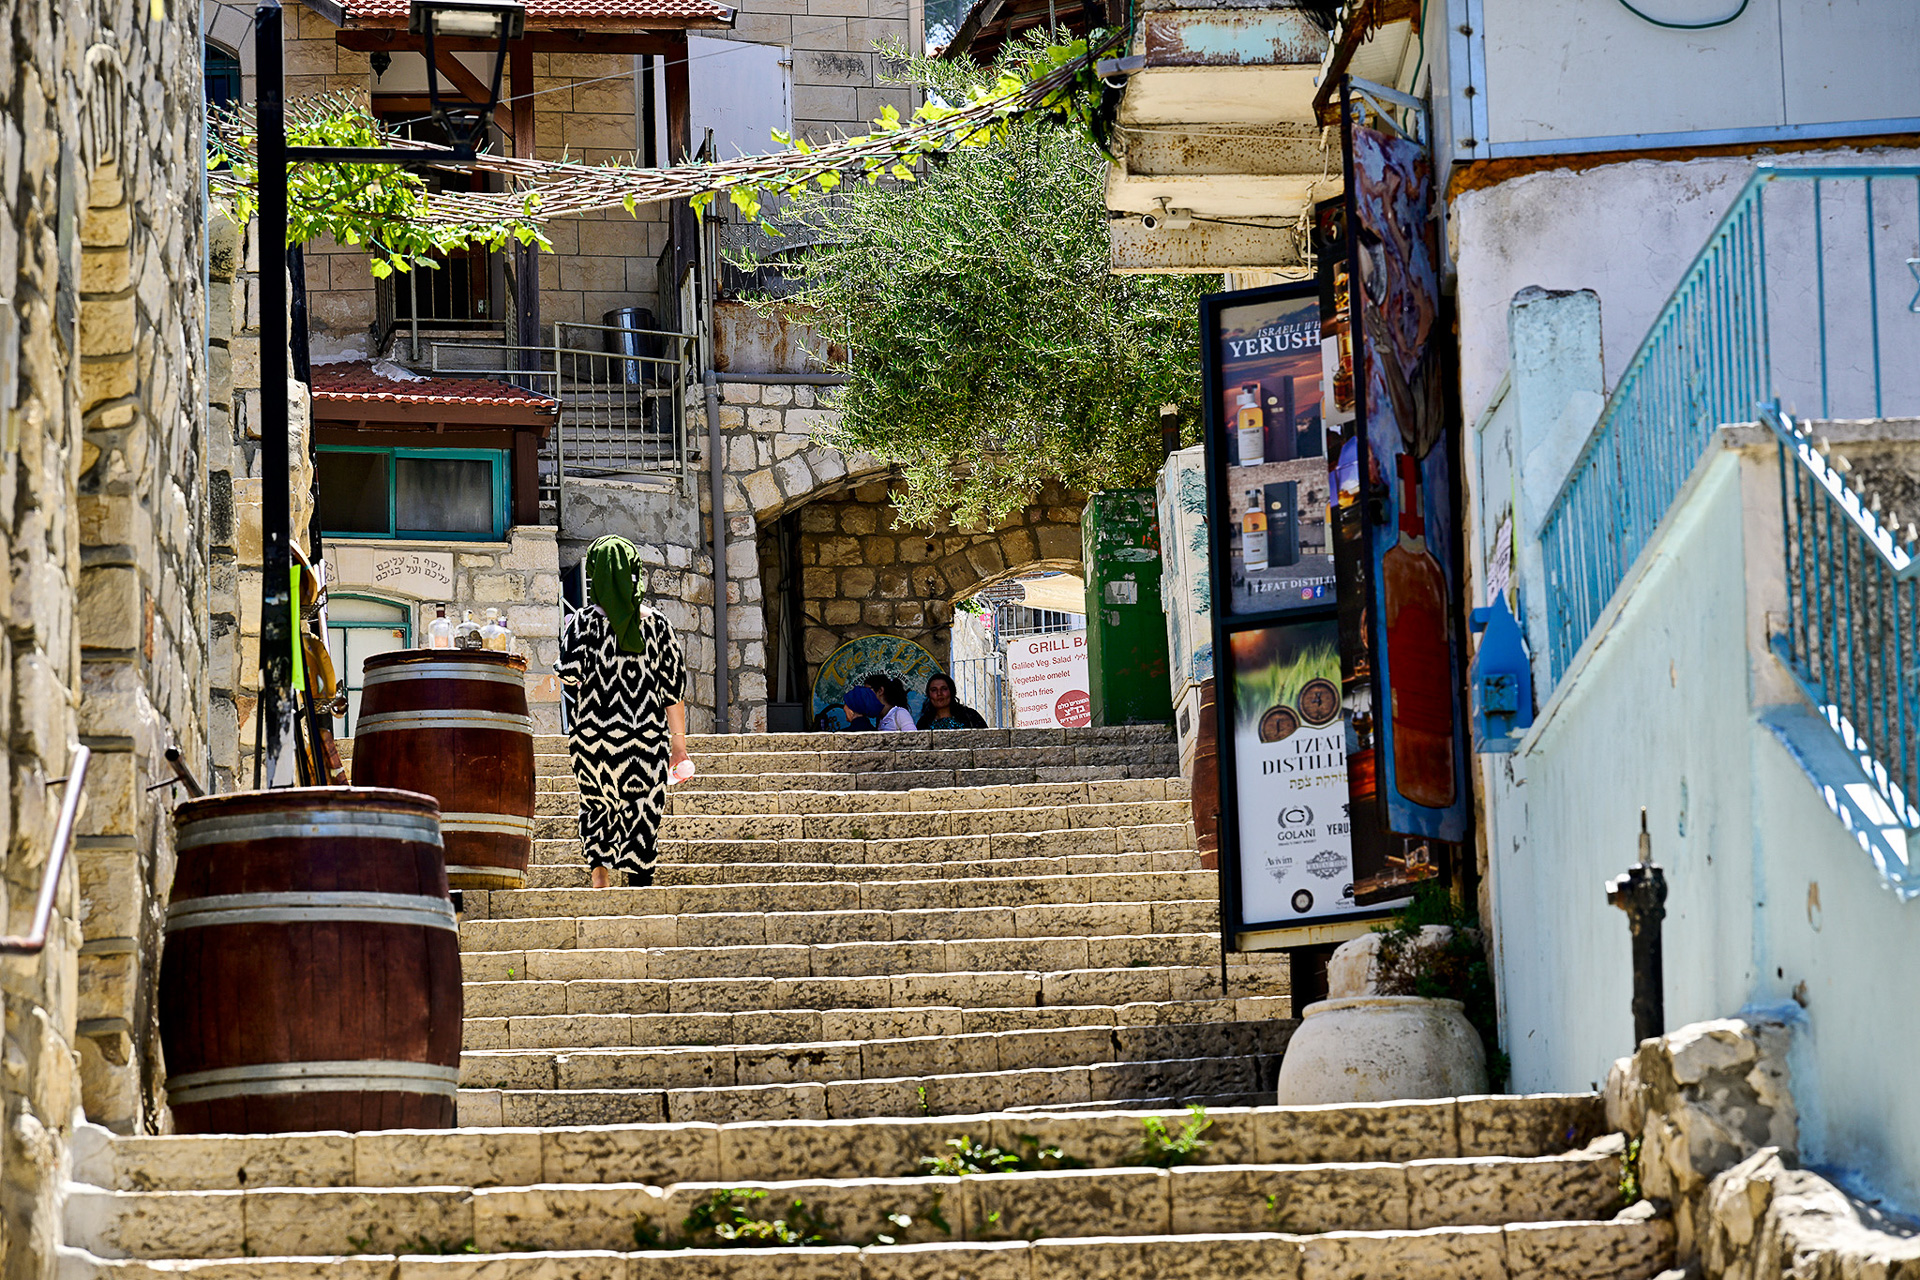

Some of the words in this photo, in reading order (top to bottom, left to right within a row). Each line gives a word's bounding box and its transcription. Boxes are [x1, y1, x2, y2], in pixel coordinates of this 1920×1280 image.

[1258, 323, 1301, 338] ISRAELI
[1304, 320, 1321, 331] WH
[1229, 329, 1321, 358] YERUSH
[375, 556, 405, 572] עליכם
[406, 565, 422, 576] ועל
[375, 567, 402, 582] בניכם
[424, 568, 451, 585] עליכם
[1253, 581, 1288, 593] TZFAT
[1028, 639, 1070, 655] GRILL
[823, 648, 865, 687] Tree
[870, 644, 887, 664] of
[890, 643, 931, 678] Life
[1011, 661, 1035, 671] Galilee
[1052, 655, 1072, 665] Salad
[1047, 670, 1071, 681] omelet
[1038, 687, 1054, 696] fries
[1292, 734, 1344, 755] TZFAT
[1277, 829, 1316, 841] GOLANI
[1326, 823, 1351, 836] YERU
